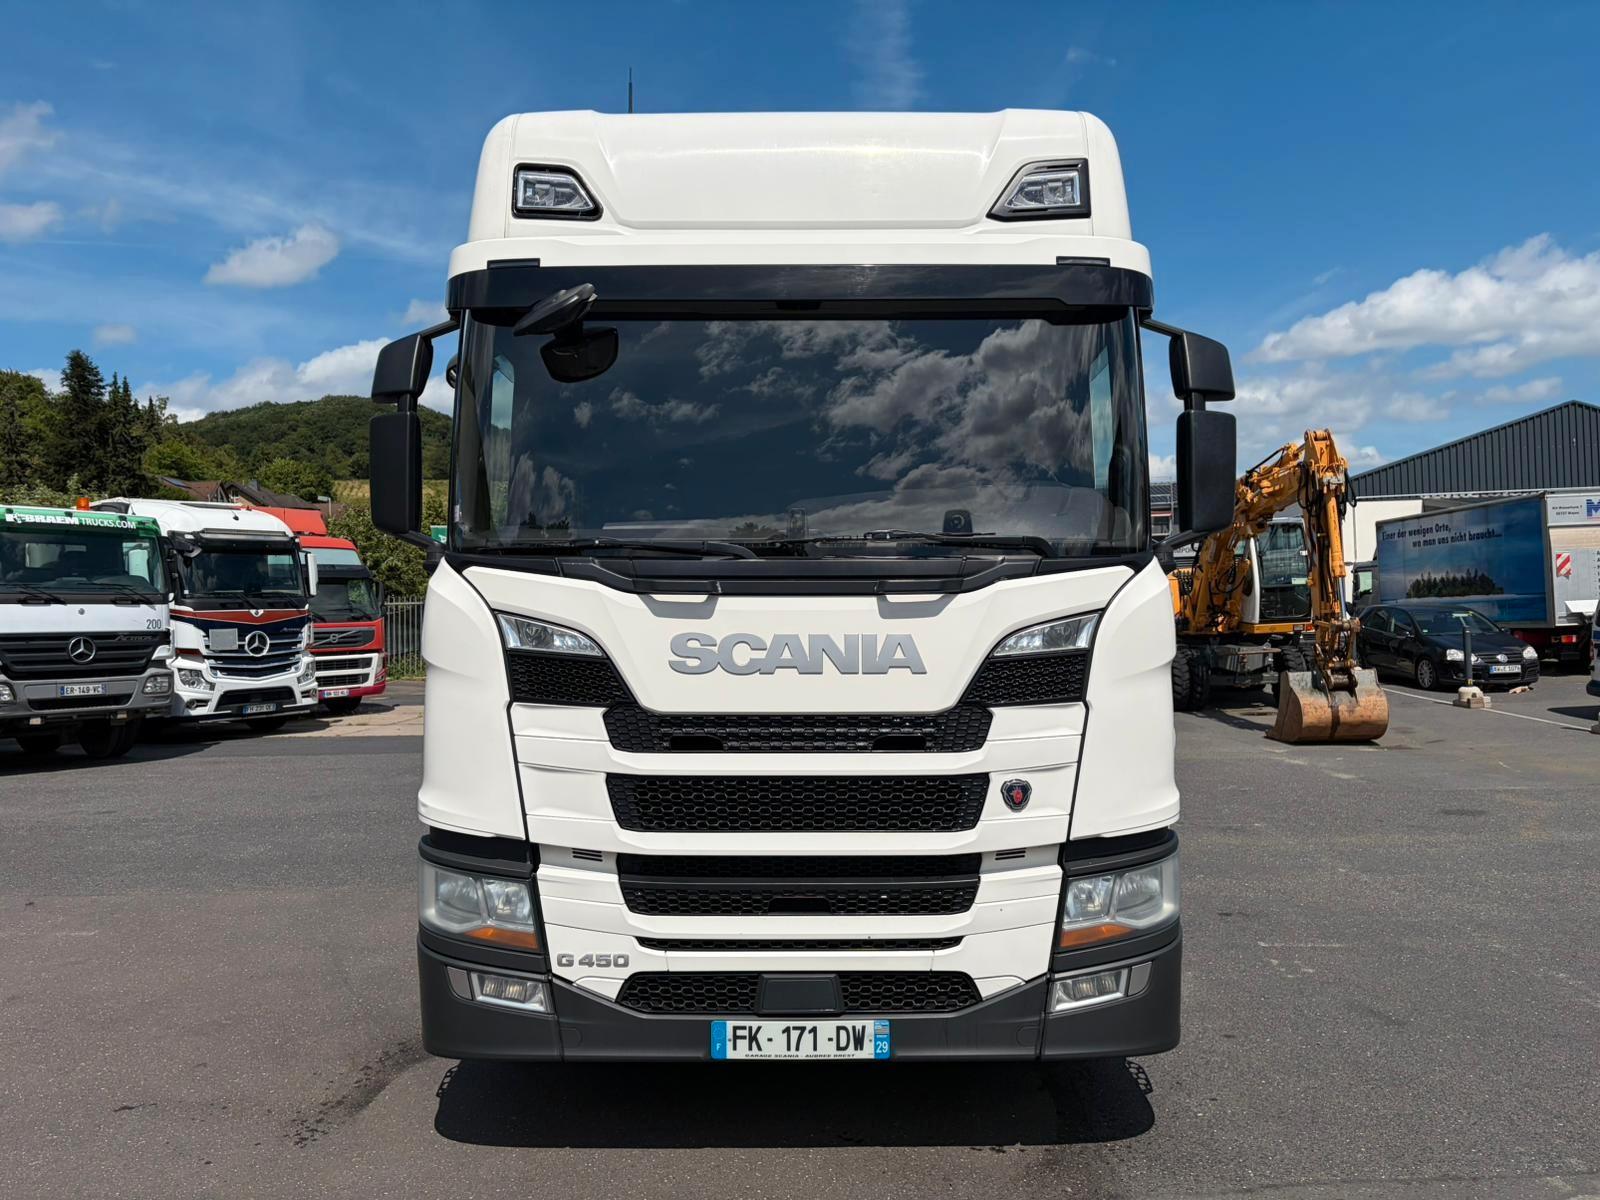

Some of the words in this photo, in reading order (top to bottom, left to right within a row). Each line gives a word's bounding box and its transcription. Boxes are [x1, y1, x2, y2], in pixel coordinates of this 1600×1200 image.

[80, 518, 137, 529] TRUCKS.COM
[1382, 531, 1396, 540] Einer
[1397, 529, 1406, 539] der
[1408, 526, 1434, 537] wenigen
[1434, 523, 1451, 533] Orte,
[1423, 538, 1437, 547] man
[1438, 537, 1449, 545] uns
[1450, 532, 1467, 544] nicht
[146, 619, 162, 630] 200
[668, 632, 928, 676] SCANIA
[556, 953, 574, 967] G
[578, 953, 629, 968] 450
[876, 1041, 889, 1053] 29
